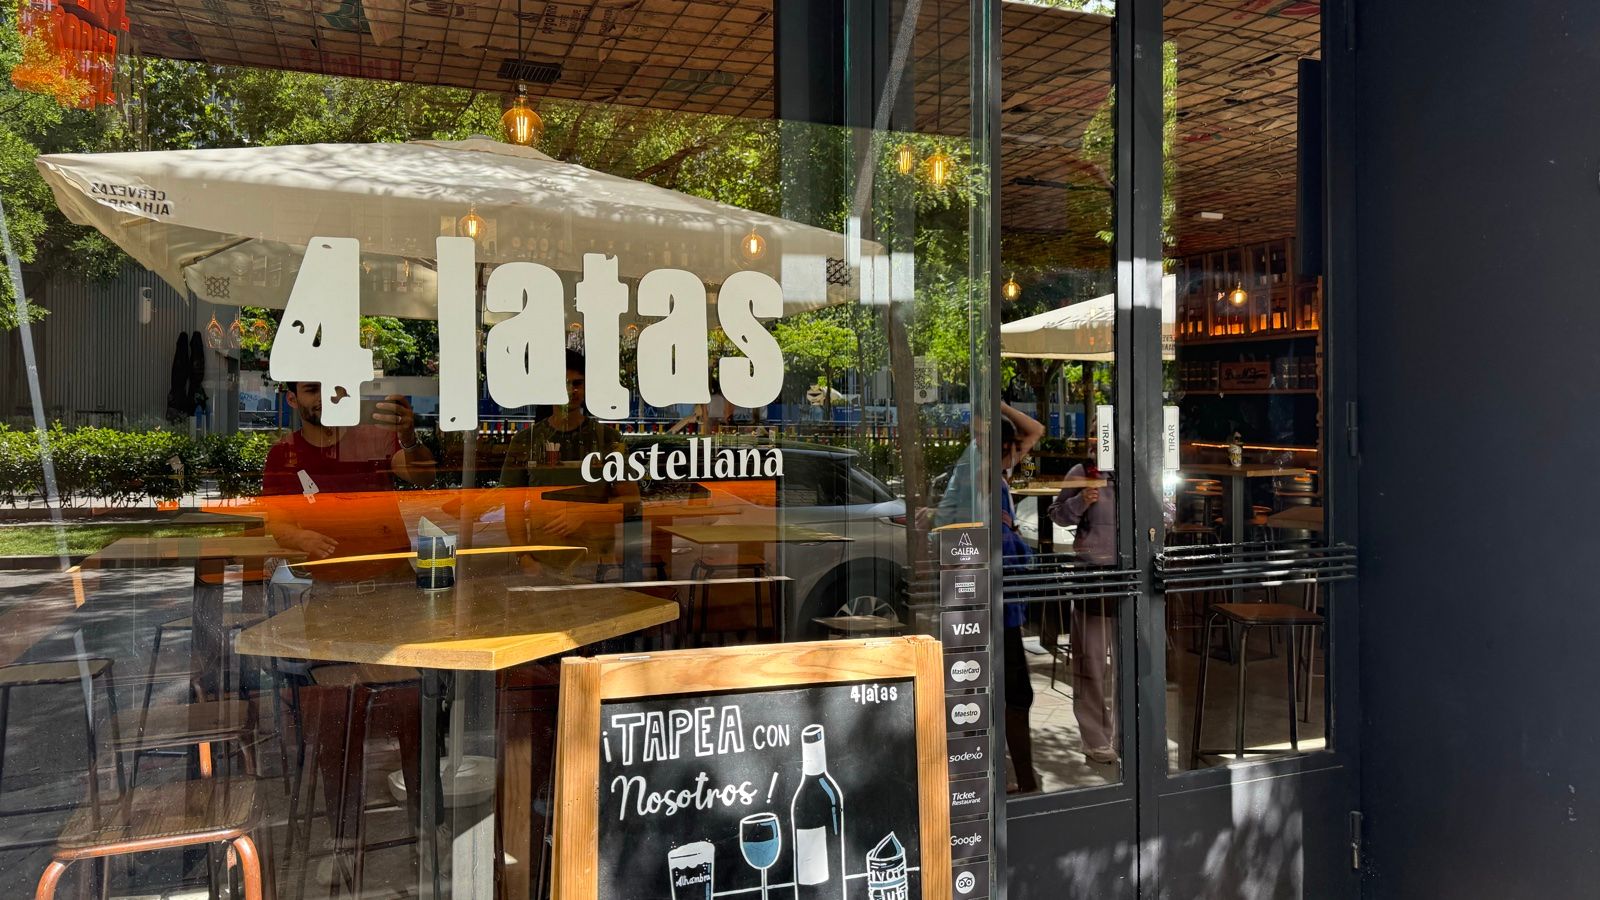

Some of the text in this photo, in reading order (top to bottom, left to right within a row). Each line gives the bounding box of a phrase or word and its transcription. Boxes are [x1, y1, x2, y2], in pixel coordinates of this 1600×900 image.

[269, 236, 784, 432] 4 latas
[1102, 424, 1110, 453] TIRAR
[1168, 424, 1176, 453] TIRAR
[581, 437, 785, 483] castellana
[951, 547, 980, 556] GALERA
[951, 623, 981, 636] VISA
[952, 667, 980, 675] MasterCard
[954, 710, 978, 718] Maestro
[753, 724, 790, 750] CON
[949, 748, 983, 763] sodexo
[952, 791, 976, 801] Ticket
[952, 798, 981, 807] Restaurant
[950, 833, 982, 846] Google
